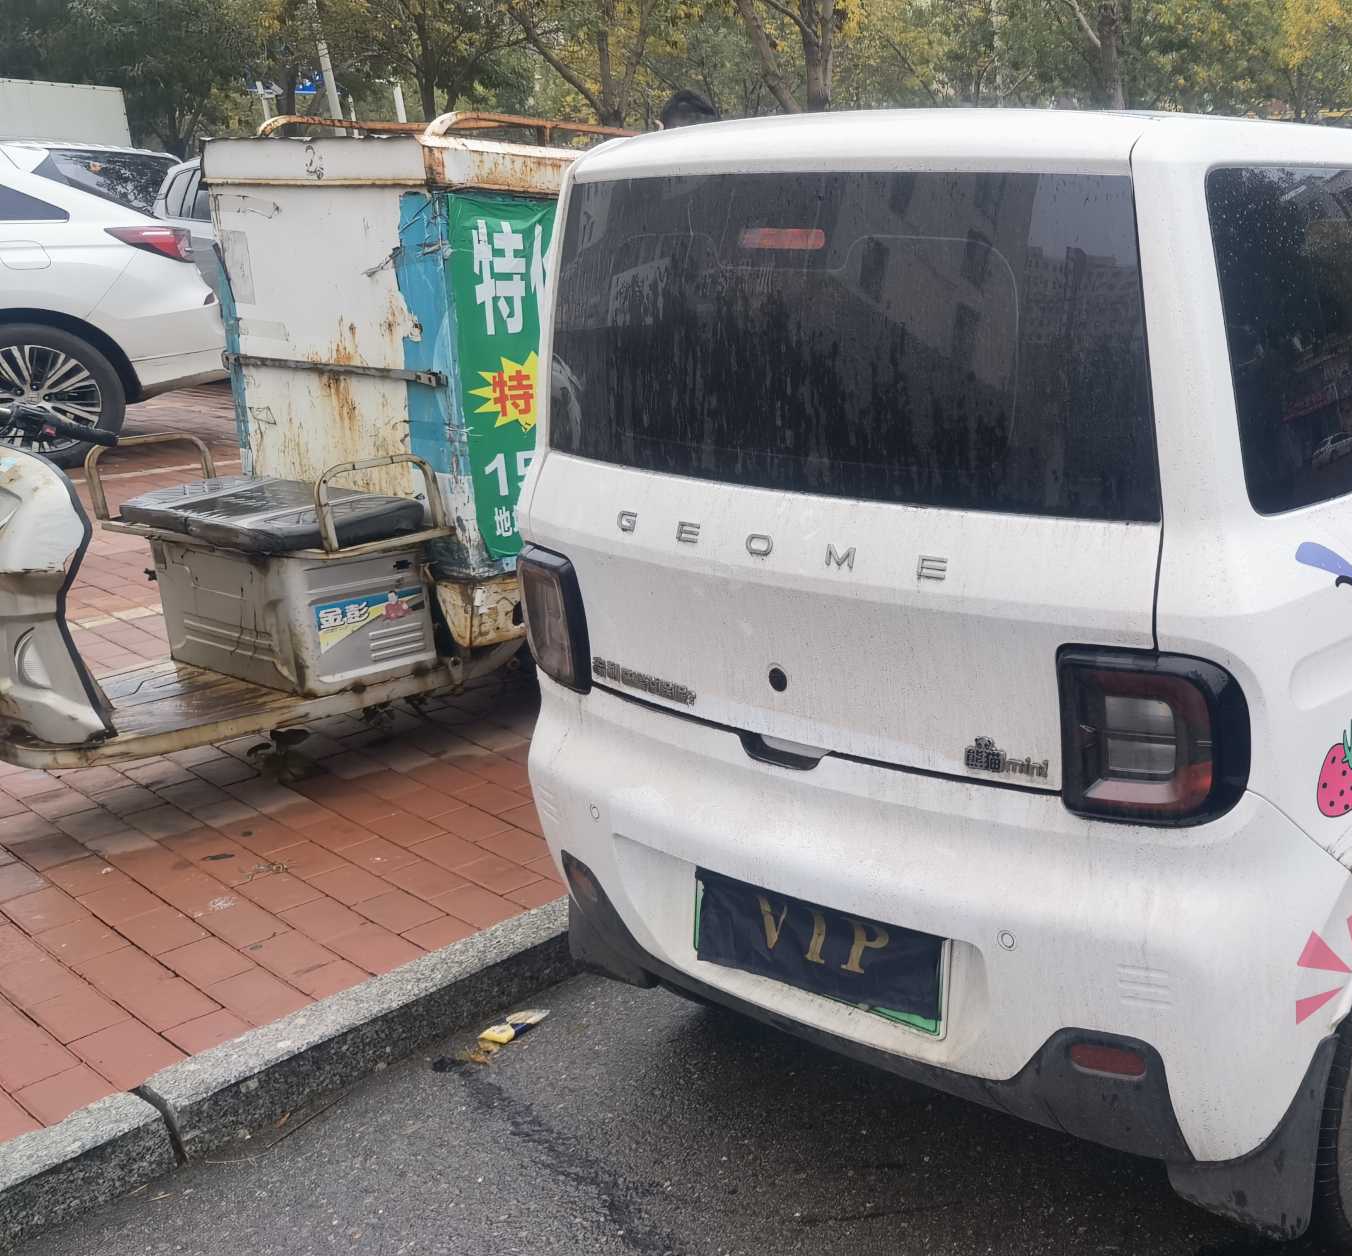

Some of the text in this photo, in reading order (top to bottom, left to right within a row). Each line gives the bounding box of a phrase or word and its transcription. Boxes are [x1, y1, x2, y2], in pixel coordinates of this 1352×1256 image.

[491, 369, 535, 417] 特
[617, 510, 948, 580] GEOME
[319, 602, 369, 629] 金彭
[757, 896, 889, 974] VIP
